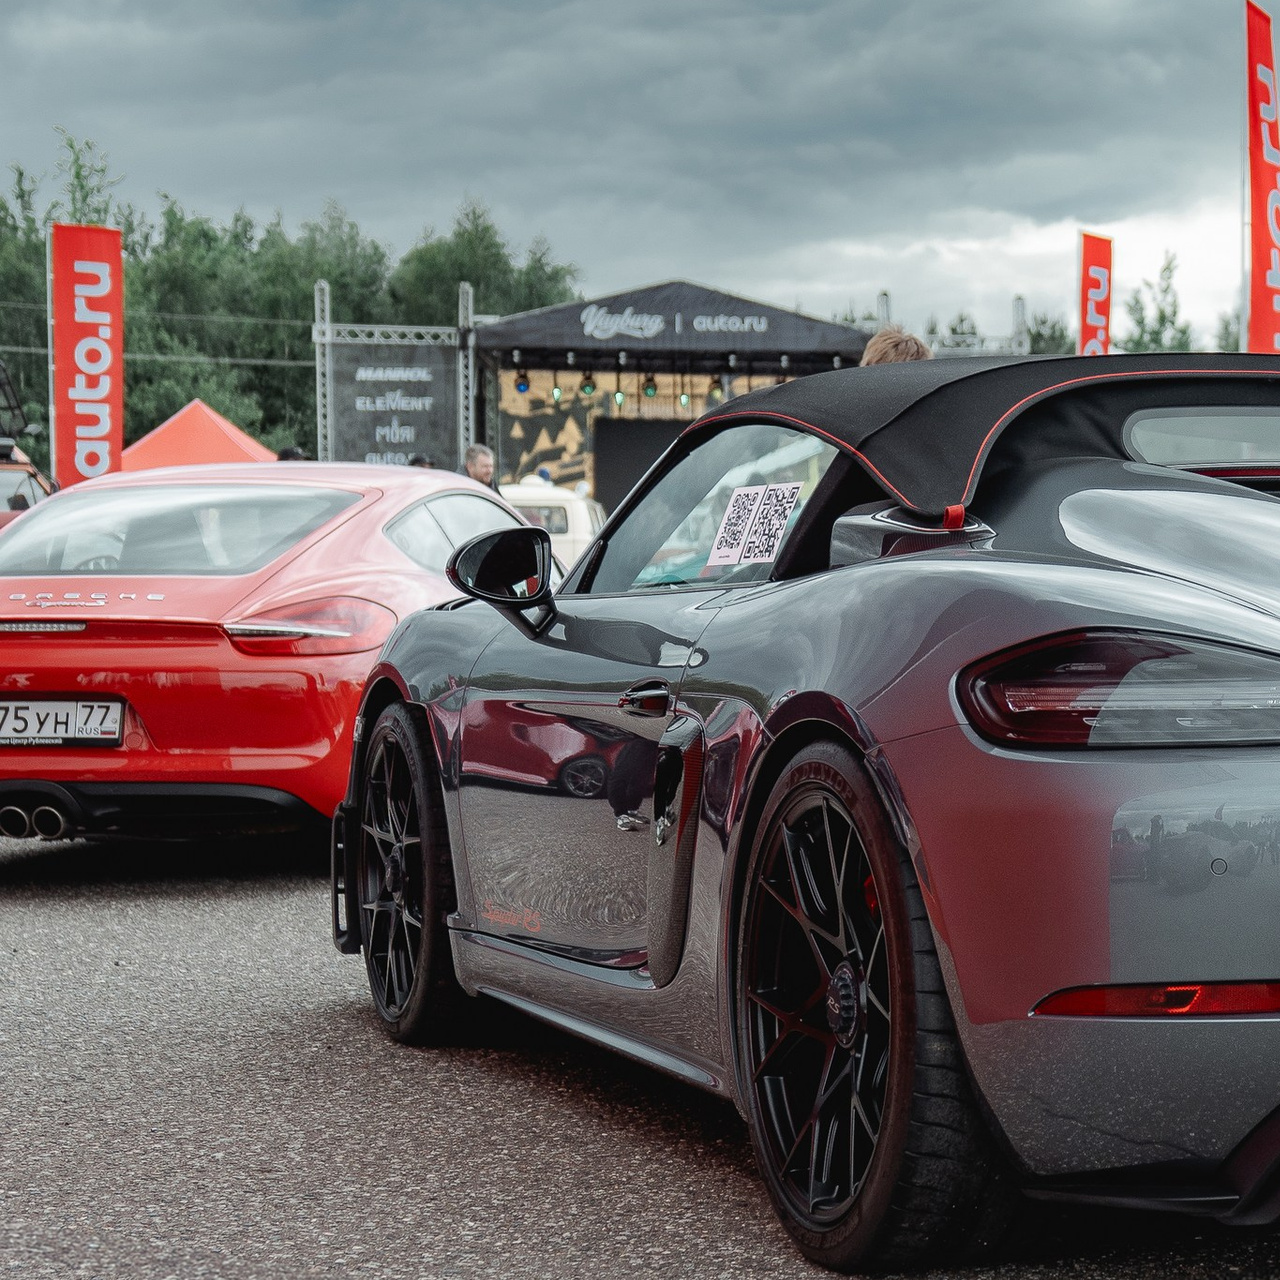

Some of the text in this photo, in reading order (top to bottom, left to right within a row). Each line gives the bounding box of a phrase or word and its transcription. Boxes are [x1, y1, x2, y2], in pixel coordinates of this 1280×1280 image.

[693, 314, 768, 333] auto.ru
[68, 260, 112, 479] auto.ru
[355, 389, 433, 411] ELEMENT
[82, 704, 110, 726] 77
[77, 727, 99, 735] RUS
